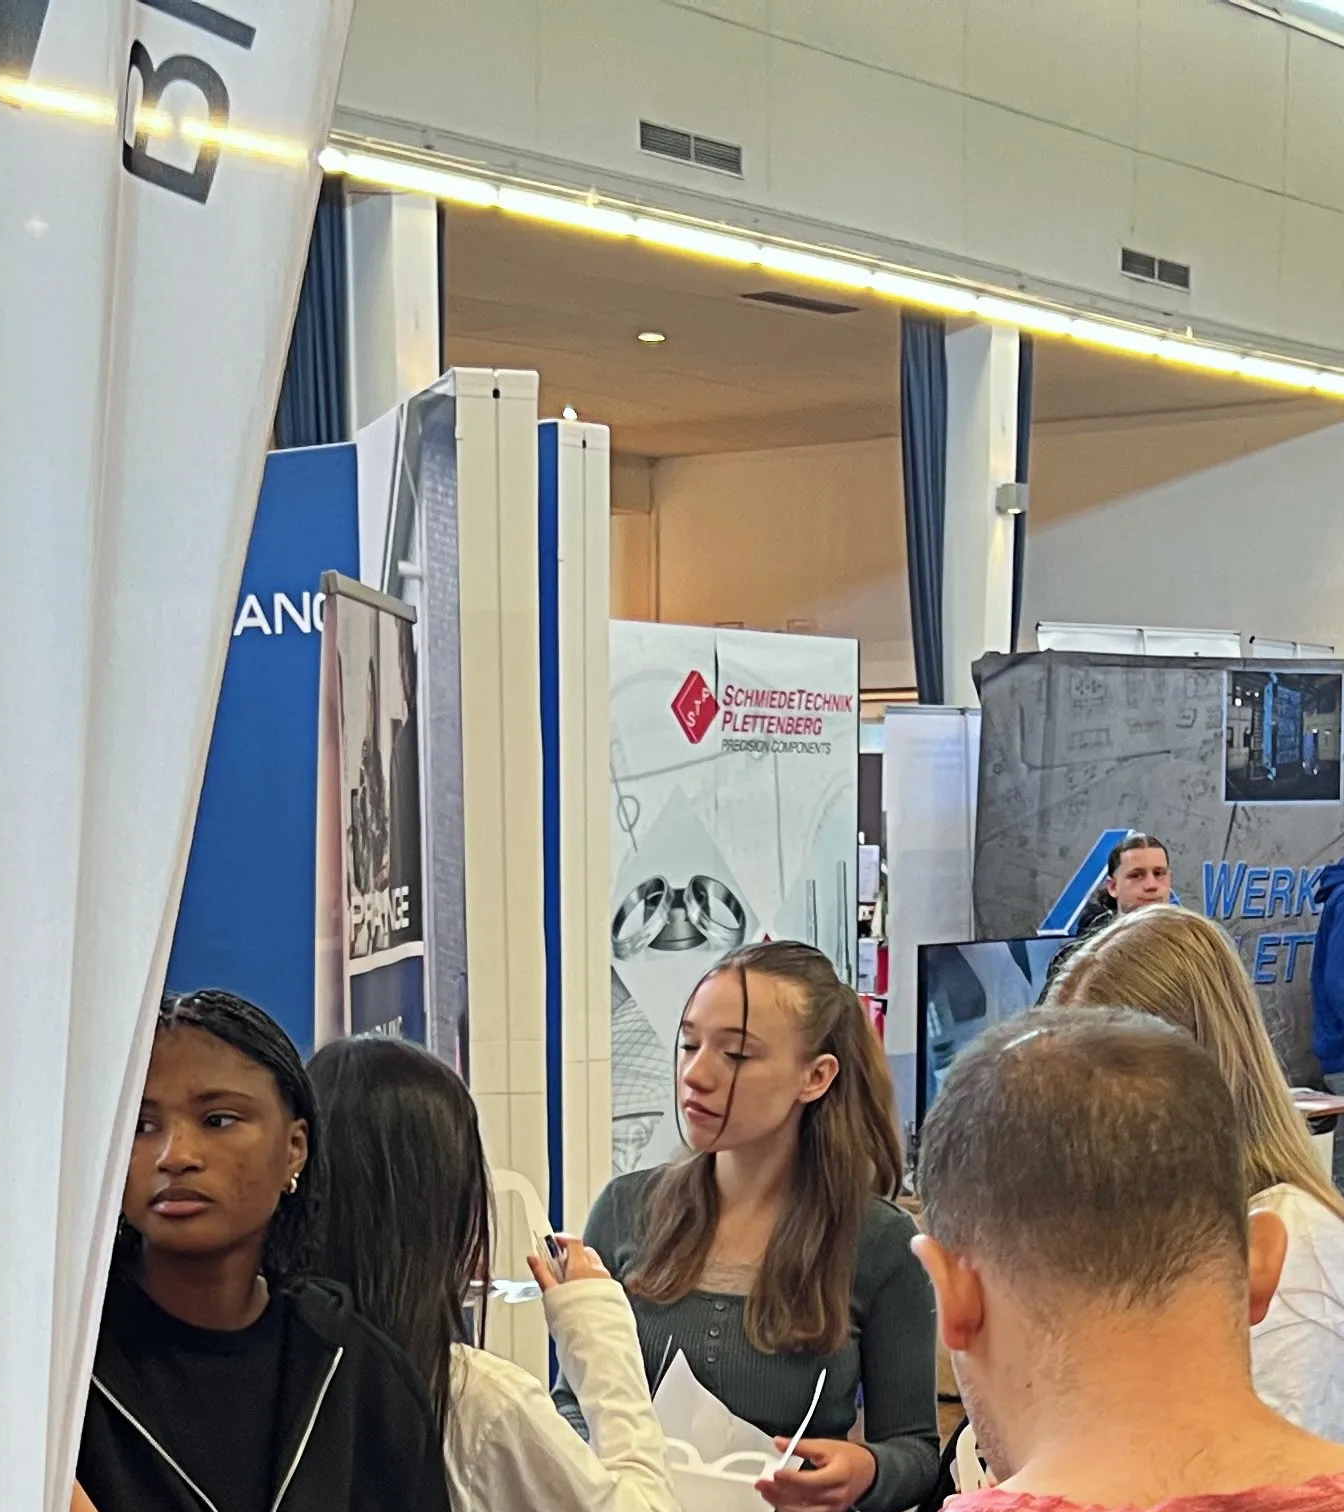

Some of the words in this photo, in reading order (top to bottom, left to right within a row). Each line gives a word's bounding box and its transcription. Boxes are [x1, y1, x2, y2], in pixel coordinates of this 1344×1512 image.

[721, 711, 824, 735] PLETTENBERG
[721, 738, 770, 753] PRECISION
[771, 740, 832, 755] COMPONENTS
